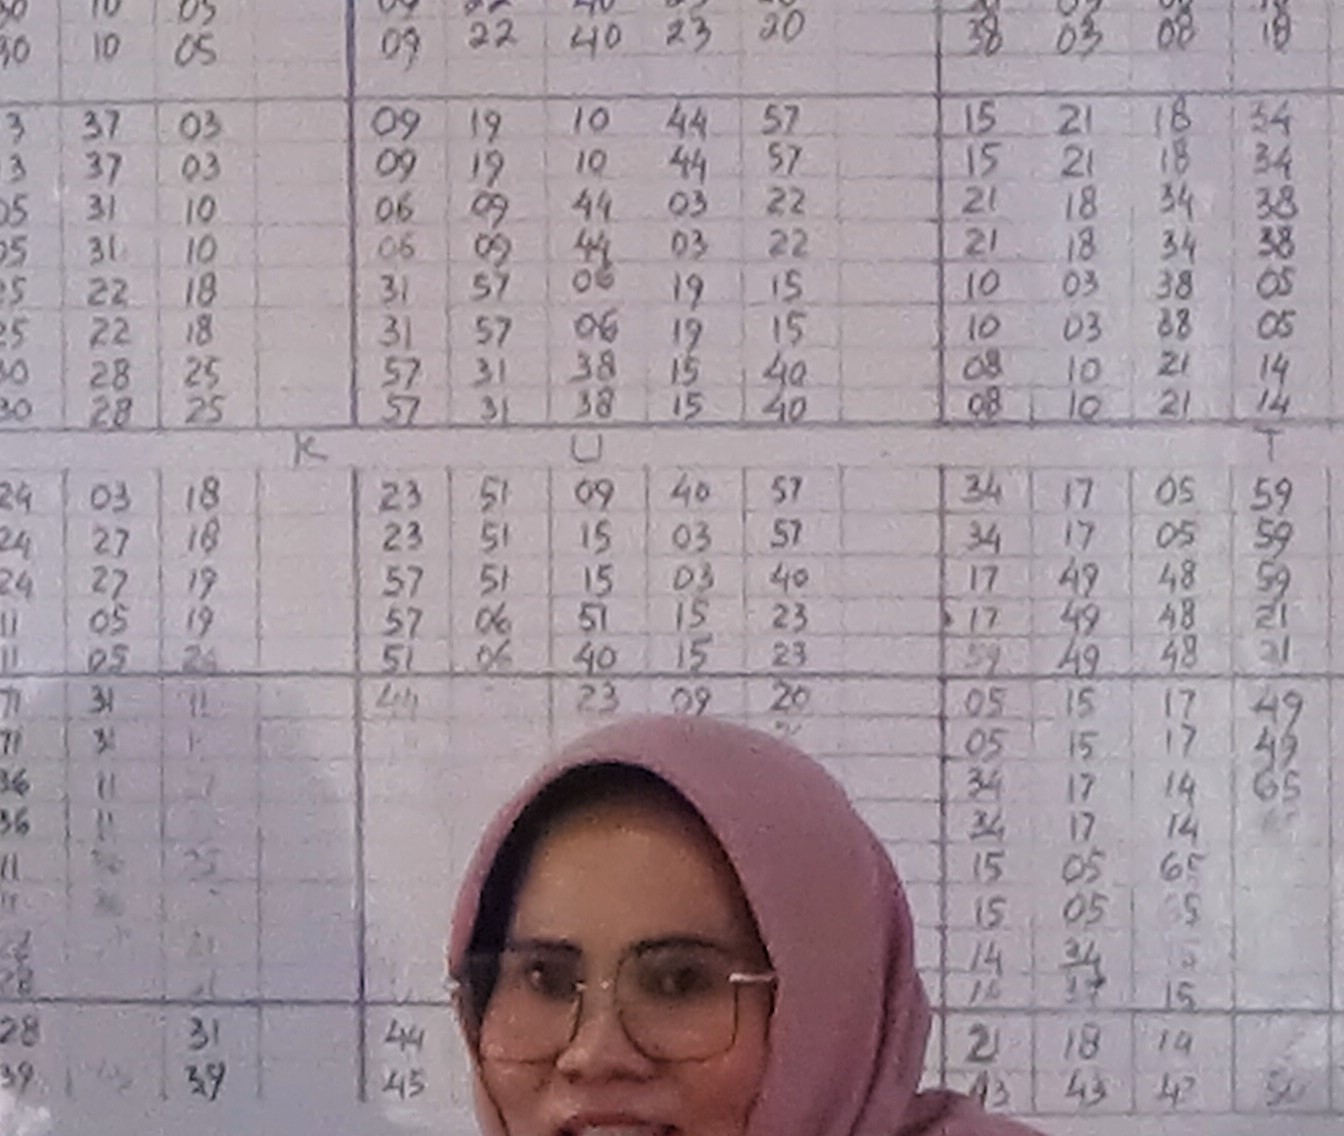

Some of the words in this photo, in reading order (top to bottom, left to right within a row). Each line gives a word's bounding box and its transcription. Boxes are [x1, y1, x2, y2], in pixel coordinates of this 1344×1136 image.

[94, 32, 118, 61] 10
[175, 33, 216, 66] 05
[88, 152, 122, 185] 37
[182, 151, 221, 178] 03
[376, 148, 416, 182] 09
[472, 148, 503, 186] 19
[578, 149, 606, 174] 10
[669, 146, 706, 180] 44
[770, 145, 801, 174] 57
[967, 143, 1000, 176] 15
[1062, 148, 1093, 175] 21
[1161, 139, 1189, 171] 18
[1256, 144, 1293, 178] 34
[88, 236, 115, 263] 31
[187, 235, 216, 262] 10
[475, 233, 511, 267] 09
[672, 232, 708, 257] 03
[771, 229, 808, 257] 22
[966, 229, 996, 257] 21
[1069, 225, 1096, 260] 18
[1163, 229, 1196, 266] 34
[295, 435, 328, 464] K
[572, 435, 602, 463] U
[1256, 429, 1281, 462] T
[91, 482, 130, 509] 03
[188, 477, 220, 509] 18
[380, 482, 421, 509] 23
[482, 479, 508, 508] 51
[576, 478, 613, 508] 09
[672, 478, 710, 504] 40
[774, 475, 802, 501] 57
[965, 477, 1000, 503] 34
[1065, 478, 1093, 509] 17
[1158, 478, 1195, 505] 05
[1250, 478, 1292, 511] 59
[93, 568, 128, 597] 27
[190, 568, 216, 598] 19
[387, 567, 423, 596] 57
[586, 565, 612, 592] 15
[674, 565, 713, 591] 03
[771, 566, 808, 590] 40
[969, 566, 999, 591] 17
[1059, 562, 1098, 596] 49
[1160, 560, 1196, 591] 48
[672, 686, 712, 714] 09
[771, 682, 809, 710] 20
[965, 688, 1005, 715] 05
[1067, 688, 1094, 713] 15
[1165, 688, 1197, 716] 17
[1250, 691, 1303, 729] 49
[967, 771, 1001, 797] 34
[1069, 773, 1094, 800] 17
[1165, 774, 1196, 801] 14
[973, 852, 1005, 879] 15
[1063, 853, 1103, 883] 05
[1065, 1024, 1099, 1060] 18
